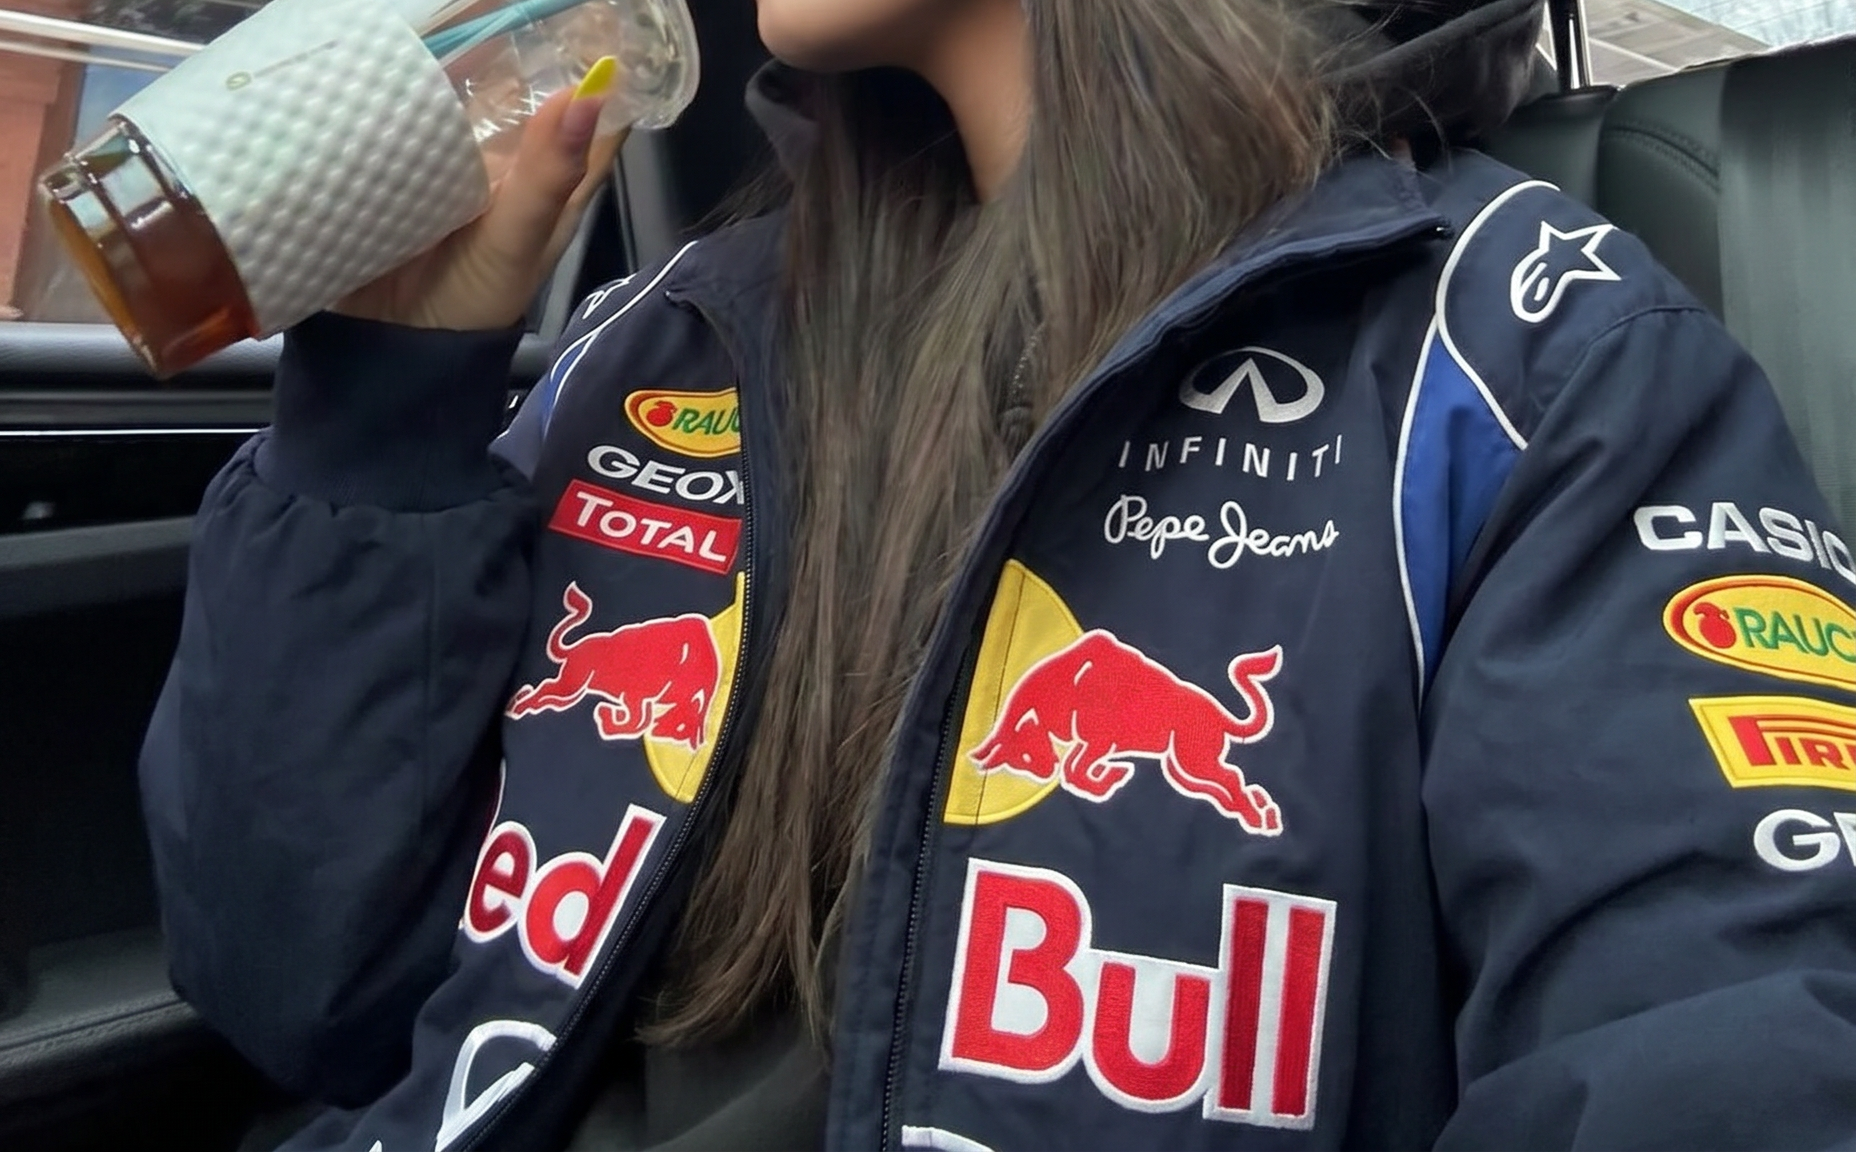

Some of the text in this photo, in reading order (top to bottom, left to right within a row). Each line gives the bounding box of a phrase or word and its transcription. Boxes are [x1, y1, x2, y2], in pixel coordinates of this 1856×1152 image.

[587, 445, 745, 505] GEOX
[1118, 435, 1342, 481] INFINITI
[576, 491, 727, 562] TOTAL
[1104, 494, 1339, 569] Pepe Jeans
[1754, 809, 1856, 871] G
[459, 803, 1337, 1130] ed Bull
